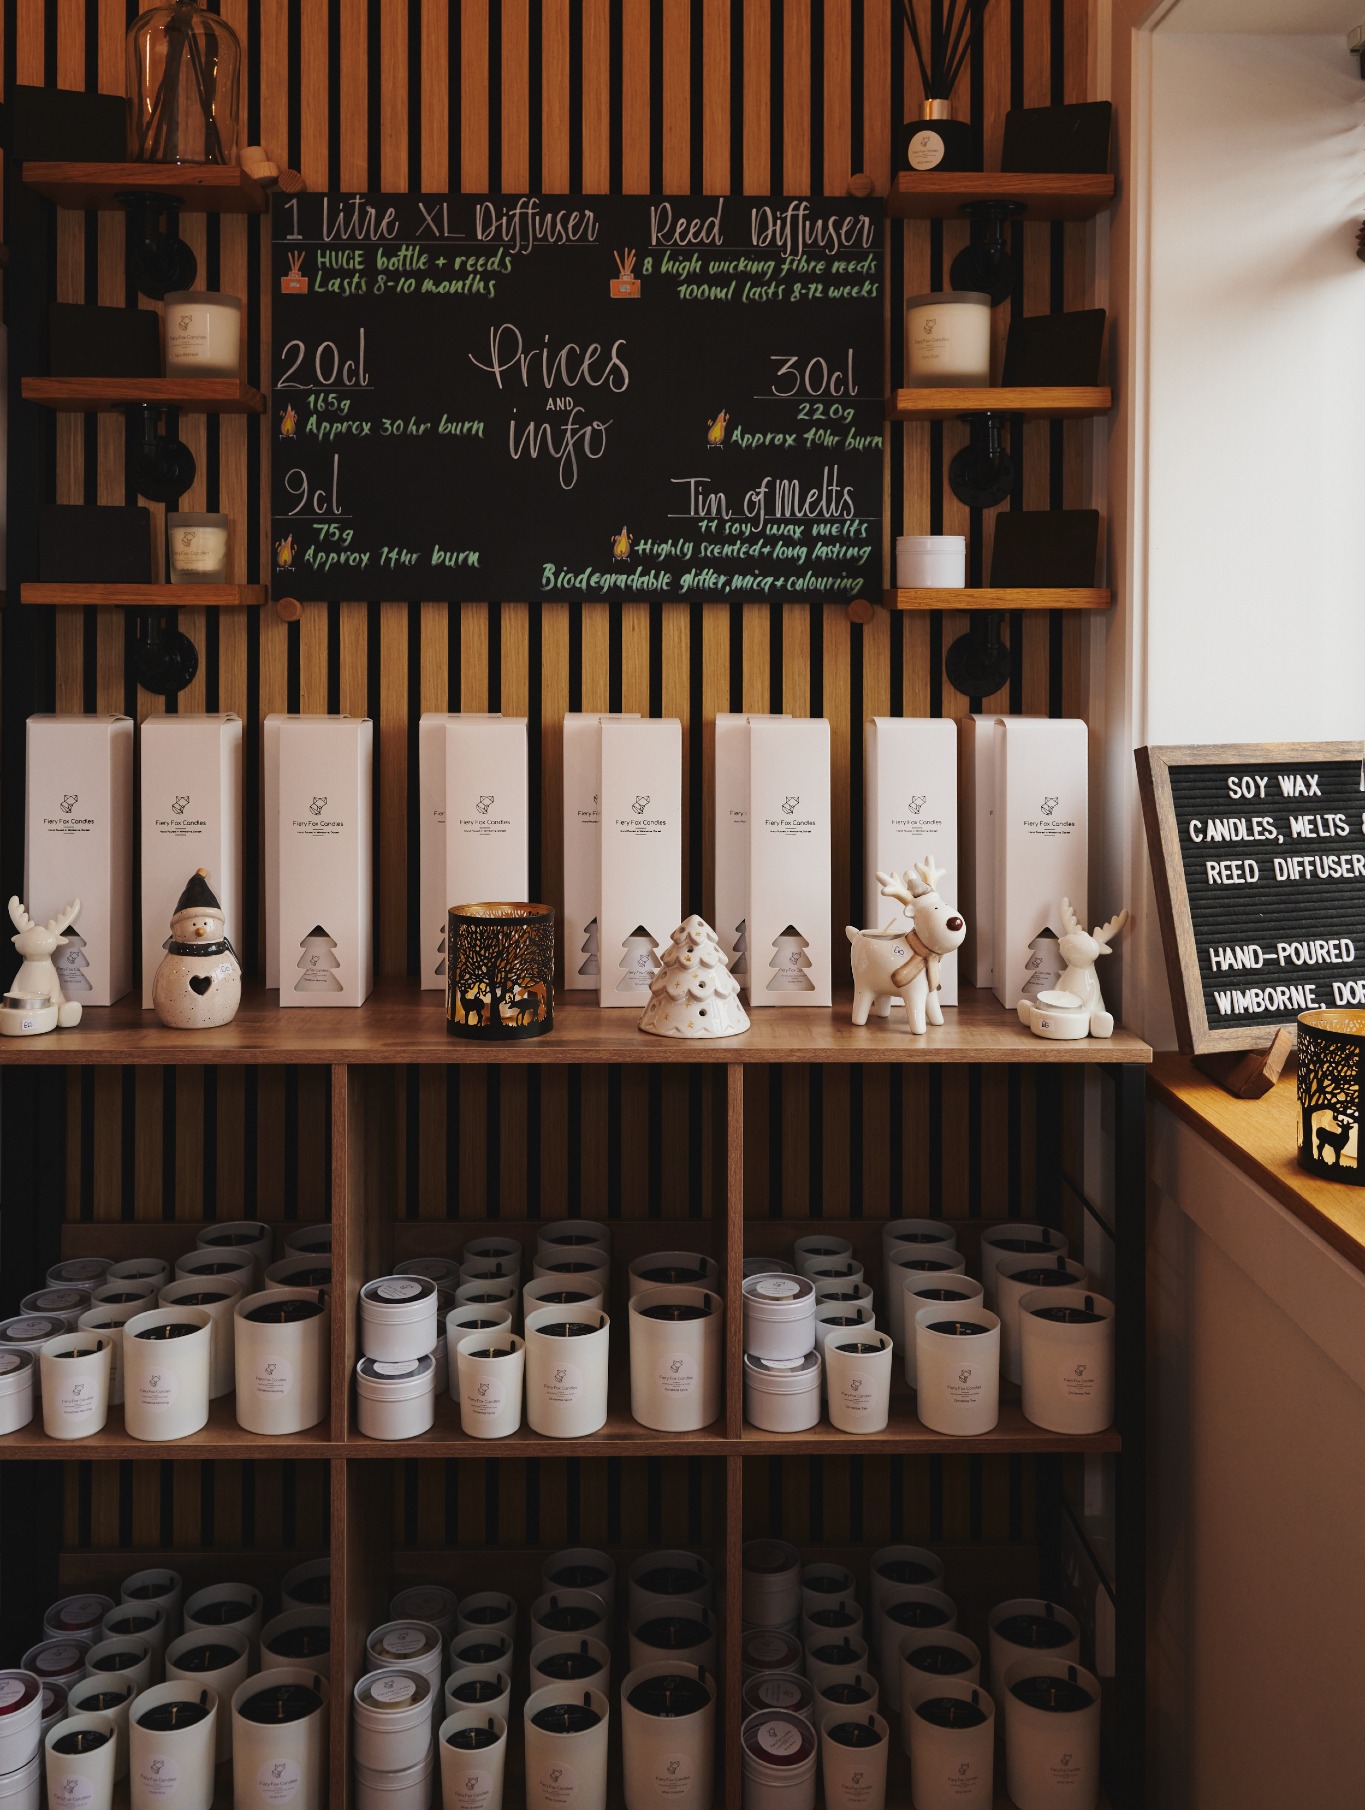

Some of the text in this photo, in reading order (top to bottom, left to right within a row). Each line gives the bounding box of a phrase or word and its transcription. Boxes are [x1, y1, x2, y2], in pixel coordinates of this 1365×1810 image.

[284, 195, 598, 254] 1 litre XL Diffuser
[650, 197, 874, 260] Reed Diffuser
[317, 244, 512, 274] HUGE bottle + reeds
[642, 256, 653, 276] 8
[660, 250, 702, 280] high
[708, 254, 776, 280] wicking
[779, 254, 827, 280] fibre
[314, 270, 496, 299] Lasts 8-10 months
[677, 280, 736, 300] 100ml
[790, 282, 824, 302] 8-12
[828, 280, 879, 298] weeks
[277, 328, 369, 388] 20cl
[468, 323, 630, 392] Prices
[770, 348, 858, 396] 30cl
[306, 392, 351, 416] 165g
[546, 396, 574, 411] AND
[796, 402, 856, 424] 220g
[306, 414, 372, 442] Approx
[438, 414, 486, 439] burn
[730, 425, 798, 450] Approx
[844, 426, 884, 452] burn
[508, 406, 614, 490] info
[284, 453, 342, 516] 9cl
[670, 464, 856, 532] Tin of Melts
[312, 523, 354, 548] 75g
[724, 522, 752, 539] soy
[766, 522, 805, 542] wax
[812, 518, 868, 539] melts
[304, 544, 370, 574] Approx
[431, 544, 481, 569] burn
[634, 538, 694, 562] Highly
[811, 541, 872, 566] lasting
[540, 562, 673, 596] Biodegradable
[1226, 774, 1322, 800] SOY WAX
[1188, 816, 1284, 844] CANDLES,
[1288, 813, 1350, 838] MELTS
[1206, 859, 1259, 885] REED
[1209, 938, 1355, 972] HAND-POURED
[1214, 984, 1326, 1016] WIMBORNE,
